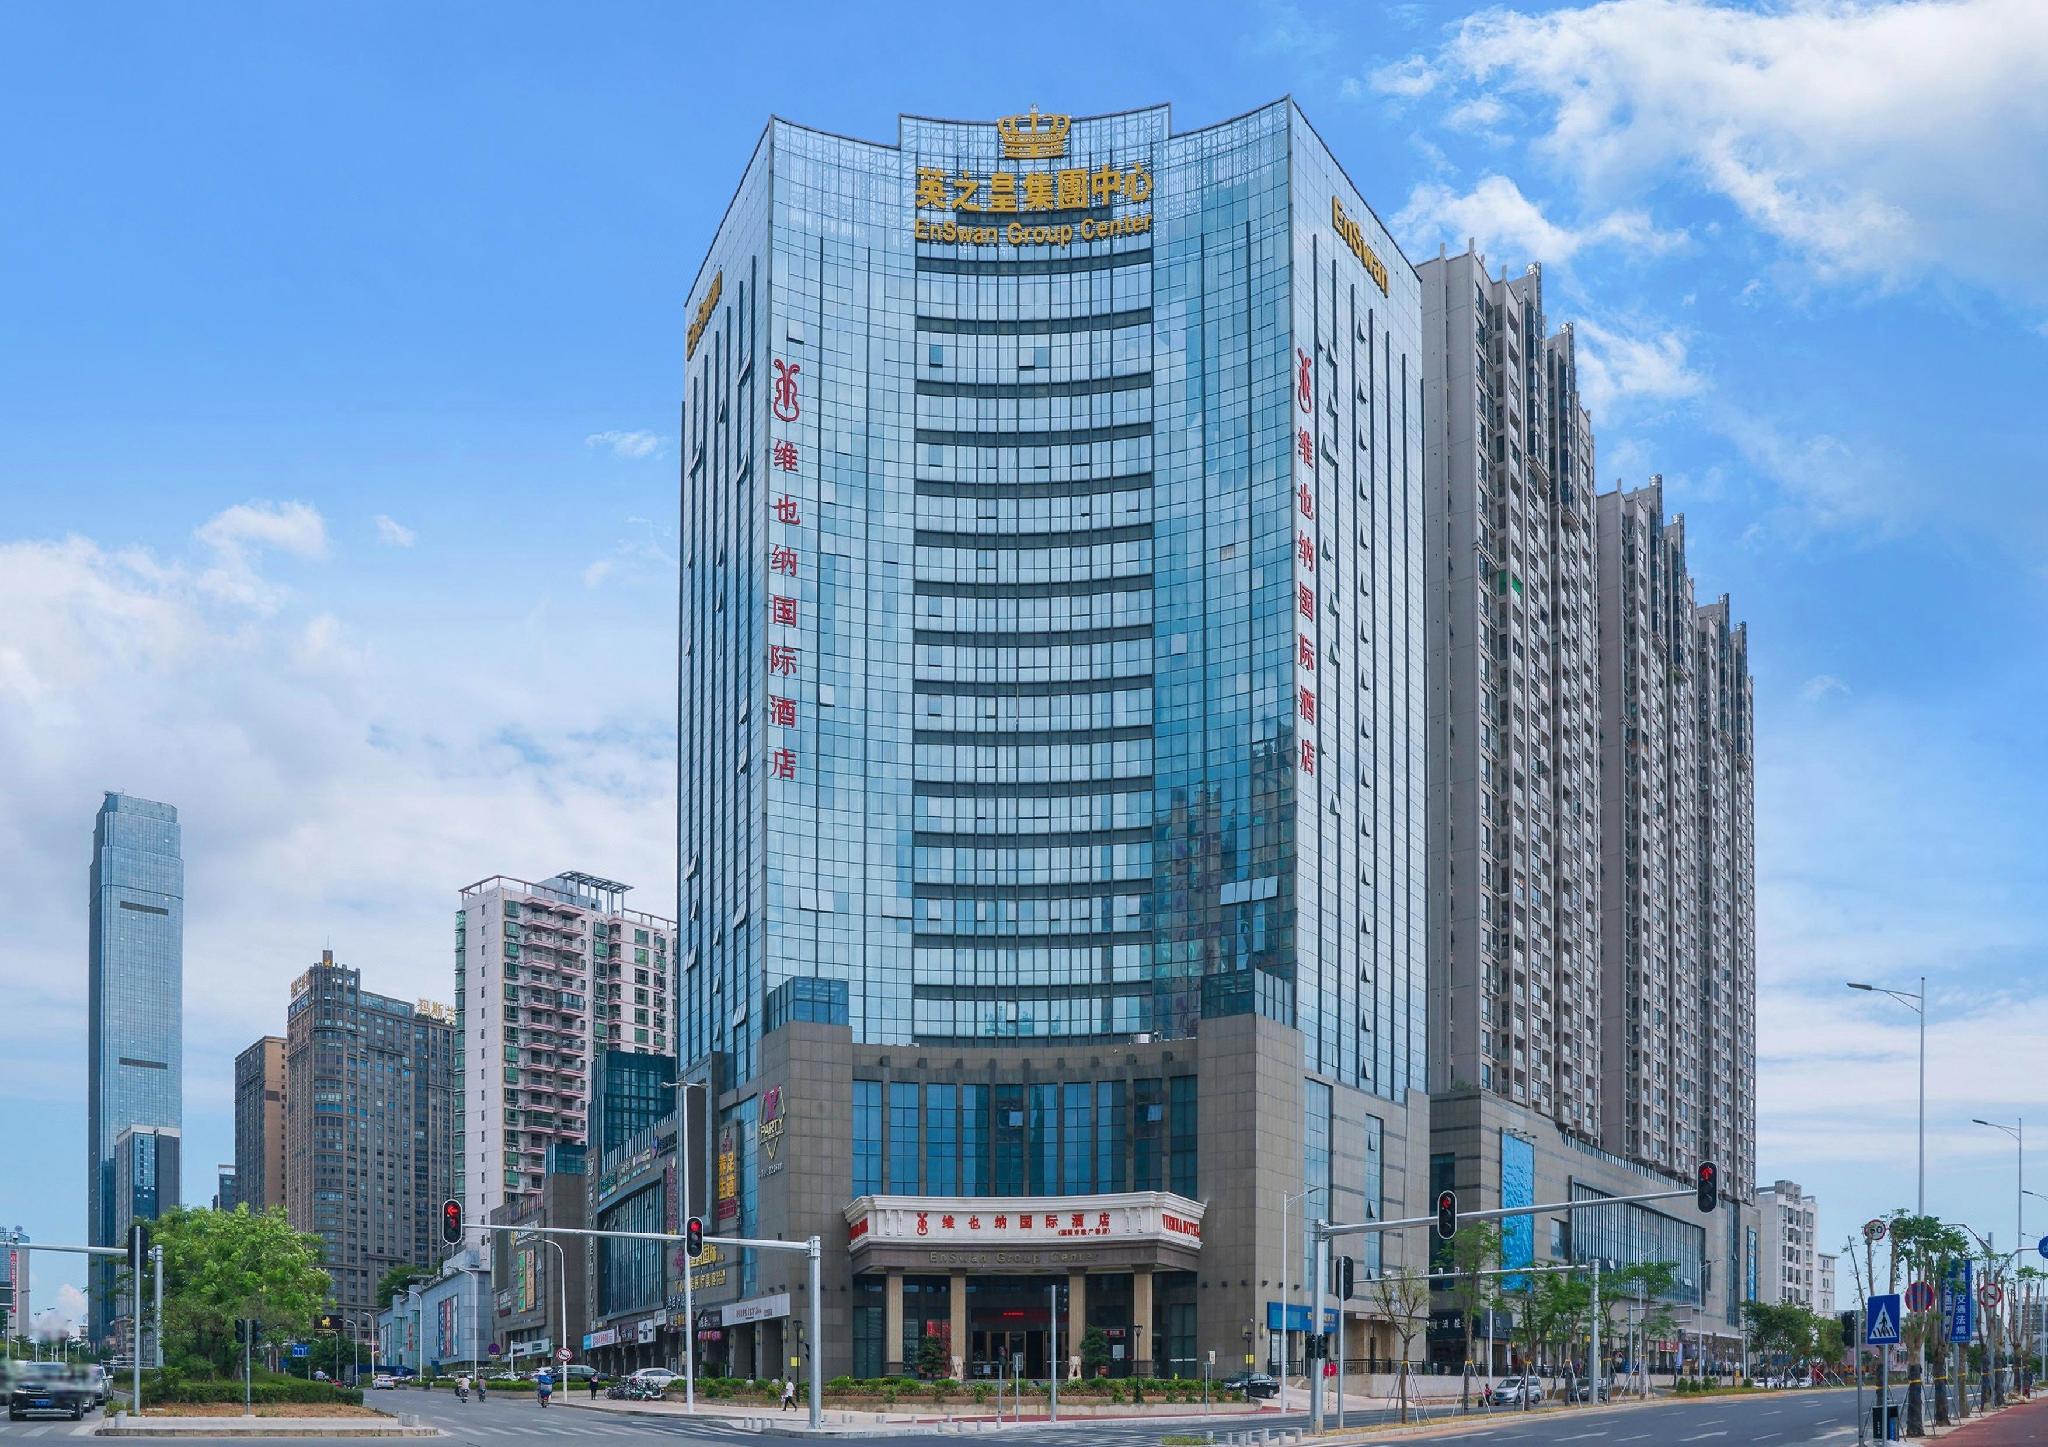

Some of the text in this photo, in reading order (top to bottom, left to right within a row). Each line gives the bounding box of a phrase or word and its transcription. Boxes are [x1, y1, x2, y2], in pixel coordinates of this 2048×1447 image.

[915, 162, 1153, 213] 英之皇集團中心
[914, 213, 1153, 247] EnSwan Group Center
[1332, 195, 1389, 299] EnSwan
[770, 437, 801, 781] 维也纳国际酒店
[1297, 427, 1315, 777] 维也纳国际酒店
[760, 1118, 783, 1137] PARTY
[941, 1212, 1111, 1230] 维也纳国际酒店
[1162, 1213, 1183, 1233] VIENNA
